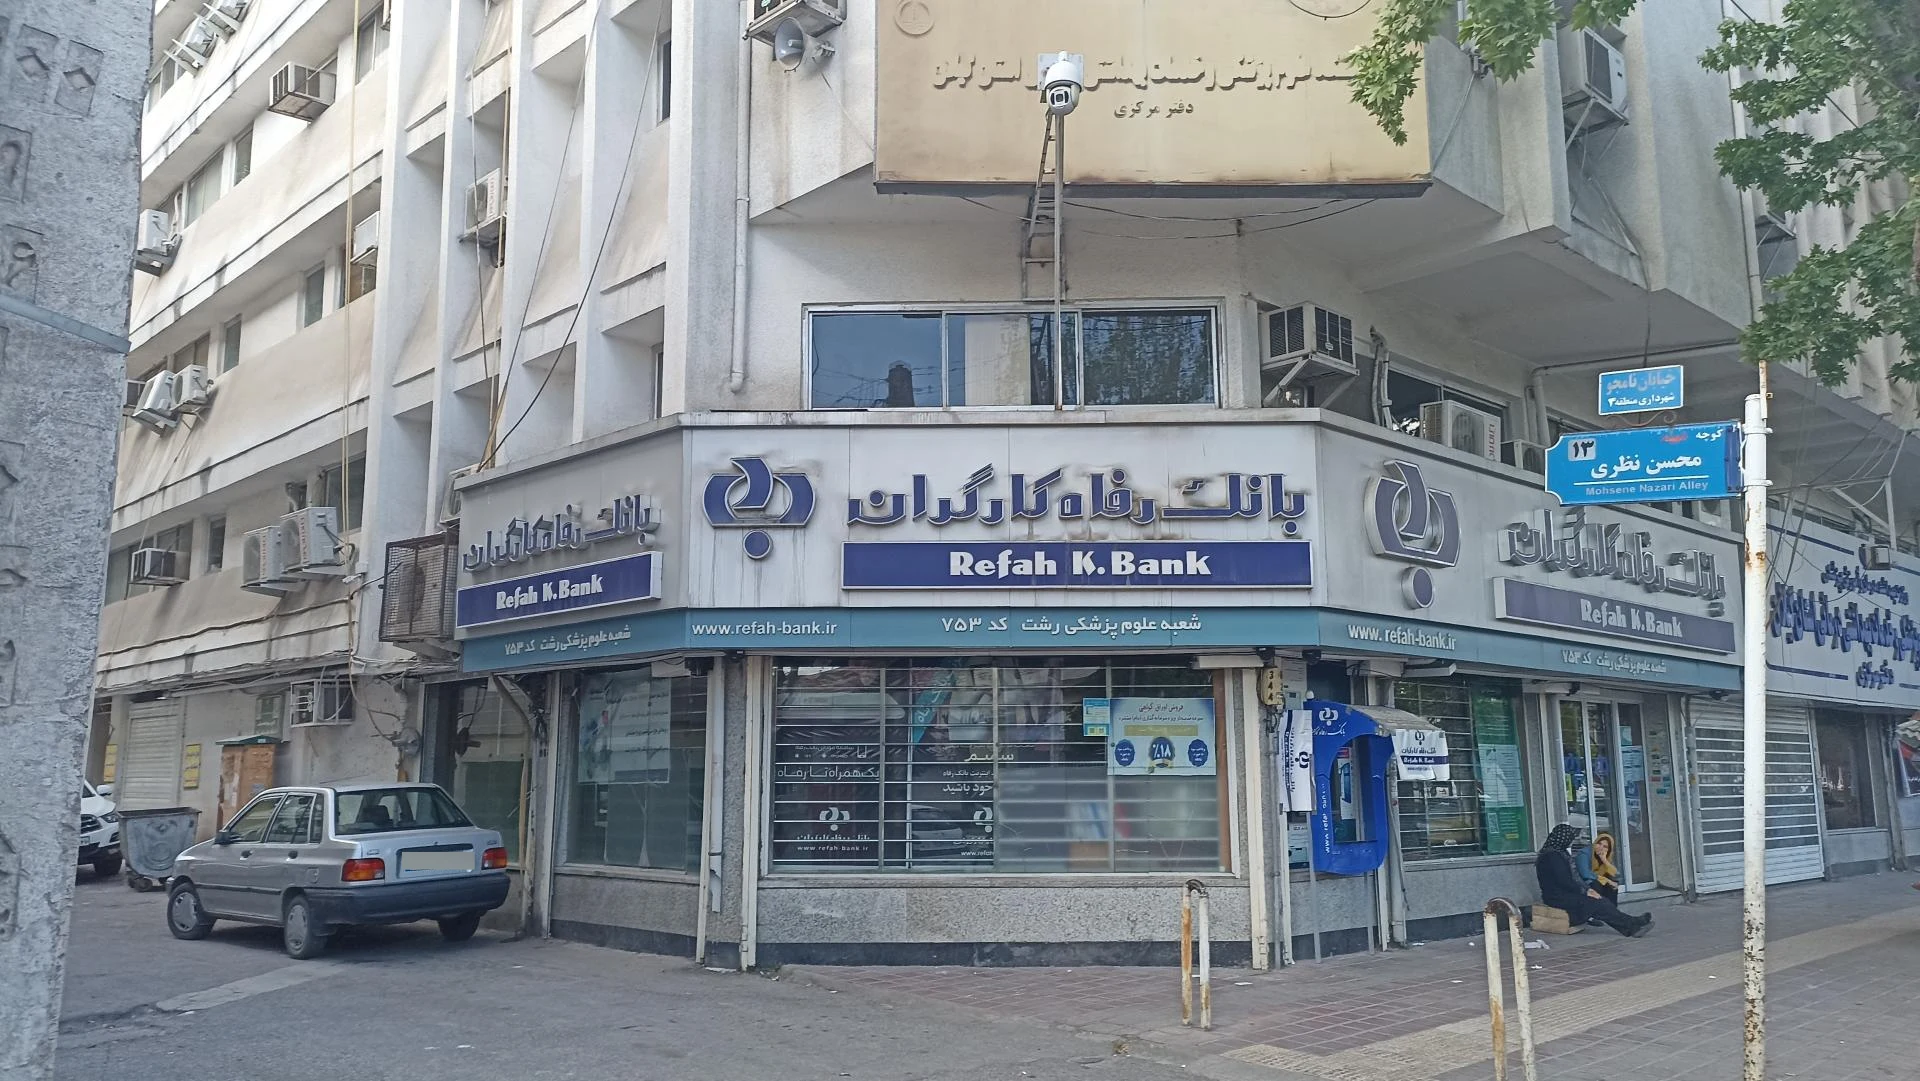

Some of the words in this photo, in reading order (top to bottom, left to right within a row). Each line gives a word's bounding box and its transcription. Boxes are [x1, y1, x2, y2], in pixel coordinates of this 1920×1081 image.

[1113, 100, 1161, 119] مرکزی
[1166, 98, 1194, 119] دفتر
[1606, 373, 1638, 396] نامجو
[1637, 369, 1676, 392] خیابان
[1638, 391, 1676, 406] شهرداری
[1694, 428, 1724, 442] کوچه
[1572, 439, 1595, 458] ۱۳
[1590, 452, 1641, 479] نظری
[1645, 454, 1703, 475] محسن
[847, 462, 1063, 526] کارگران
[1057, 467, 1156, 526] رفاه
[1585, 484, 1636, 497] Mohsene
[1639, 482, 1676, 494] Nazari
[1678, 480, 1709, 493] Alley
[1161, 472, 1307, 536] بانک
[541, 503, 583, 552] رفاه
[584, 493, 660, 547] بانک
[462, 514, 546, 571] کارگران
[1498, 506, 1621, 577] کارگران
[949, 549, 1058, 580] Refah
[1622, 531, 1667, 593] رفاه
[1666, 549, 1726, 618] بانک
[495, 585, 538, 610] Refah
[1580, 598, 1627, 628] Refah
[691, 620, 838, 635] www.refah-bank.ir
[941, 616, 982, 632] ۷۵۳
[987, 617, 1008, 631] کد
[1020, 616, 1060, 635] رشت
[1064, 615, 1119, 639] پزشکی
[1121, 618, 1157, 635] علوم
[1160, 613, 1202, 636] شعبه
[540, 635, 560, 652] رشت
[560, 632, 588, 651] پزشکی
[588, 630, 608, 648] علوم
[608, 624, 632, 646] شعبه
[504, 641, 525, 655] ۷۵۳
[524, 639, 535, 652] کد
[1561, 649, 1582, 665] ۷۵۳
[1582, 650, 1592, 664] کد
[1595, 652, 1615, 671] رشت
[1614, 653, 1637, 677] پزشکی
[1635, 660, 1651, 674] علوم
[1649, 660, 1667, 677] شعبه
[777, 765, 808, 780] رفاه
[829, 765, 861, 780] همراه
